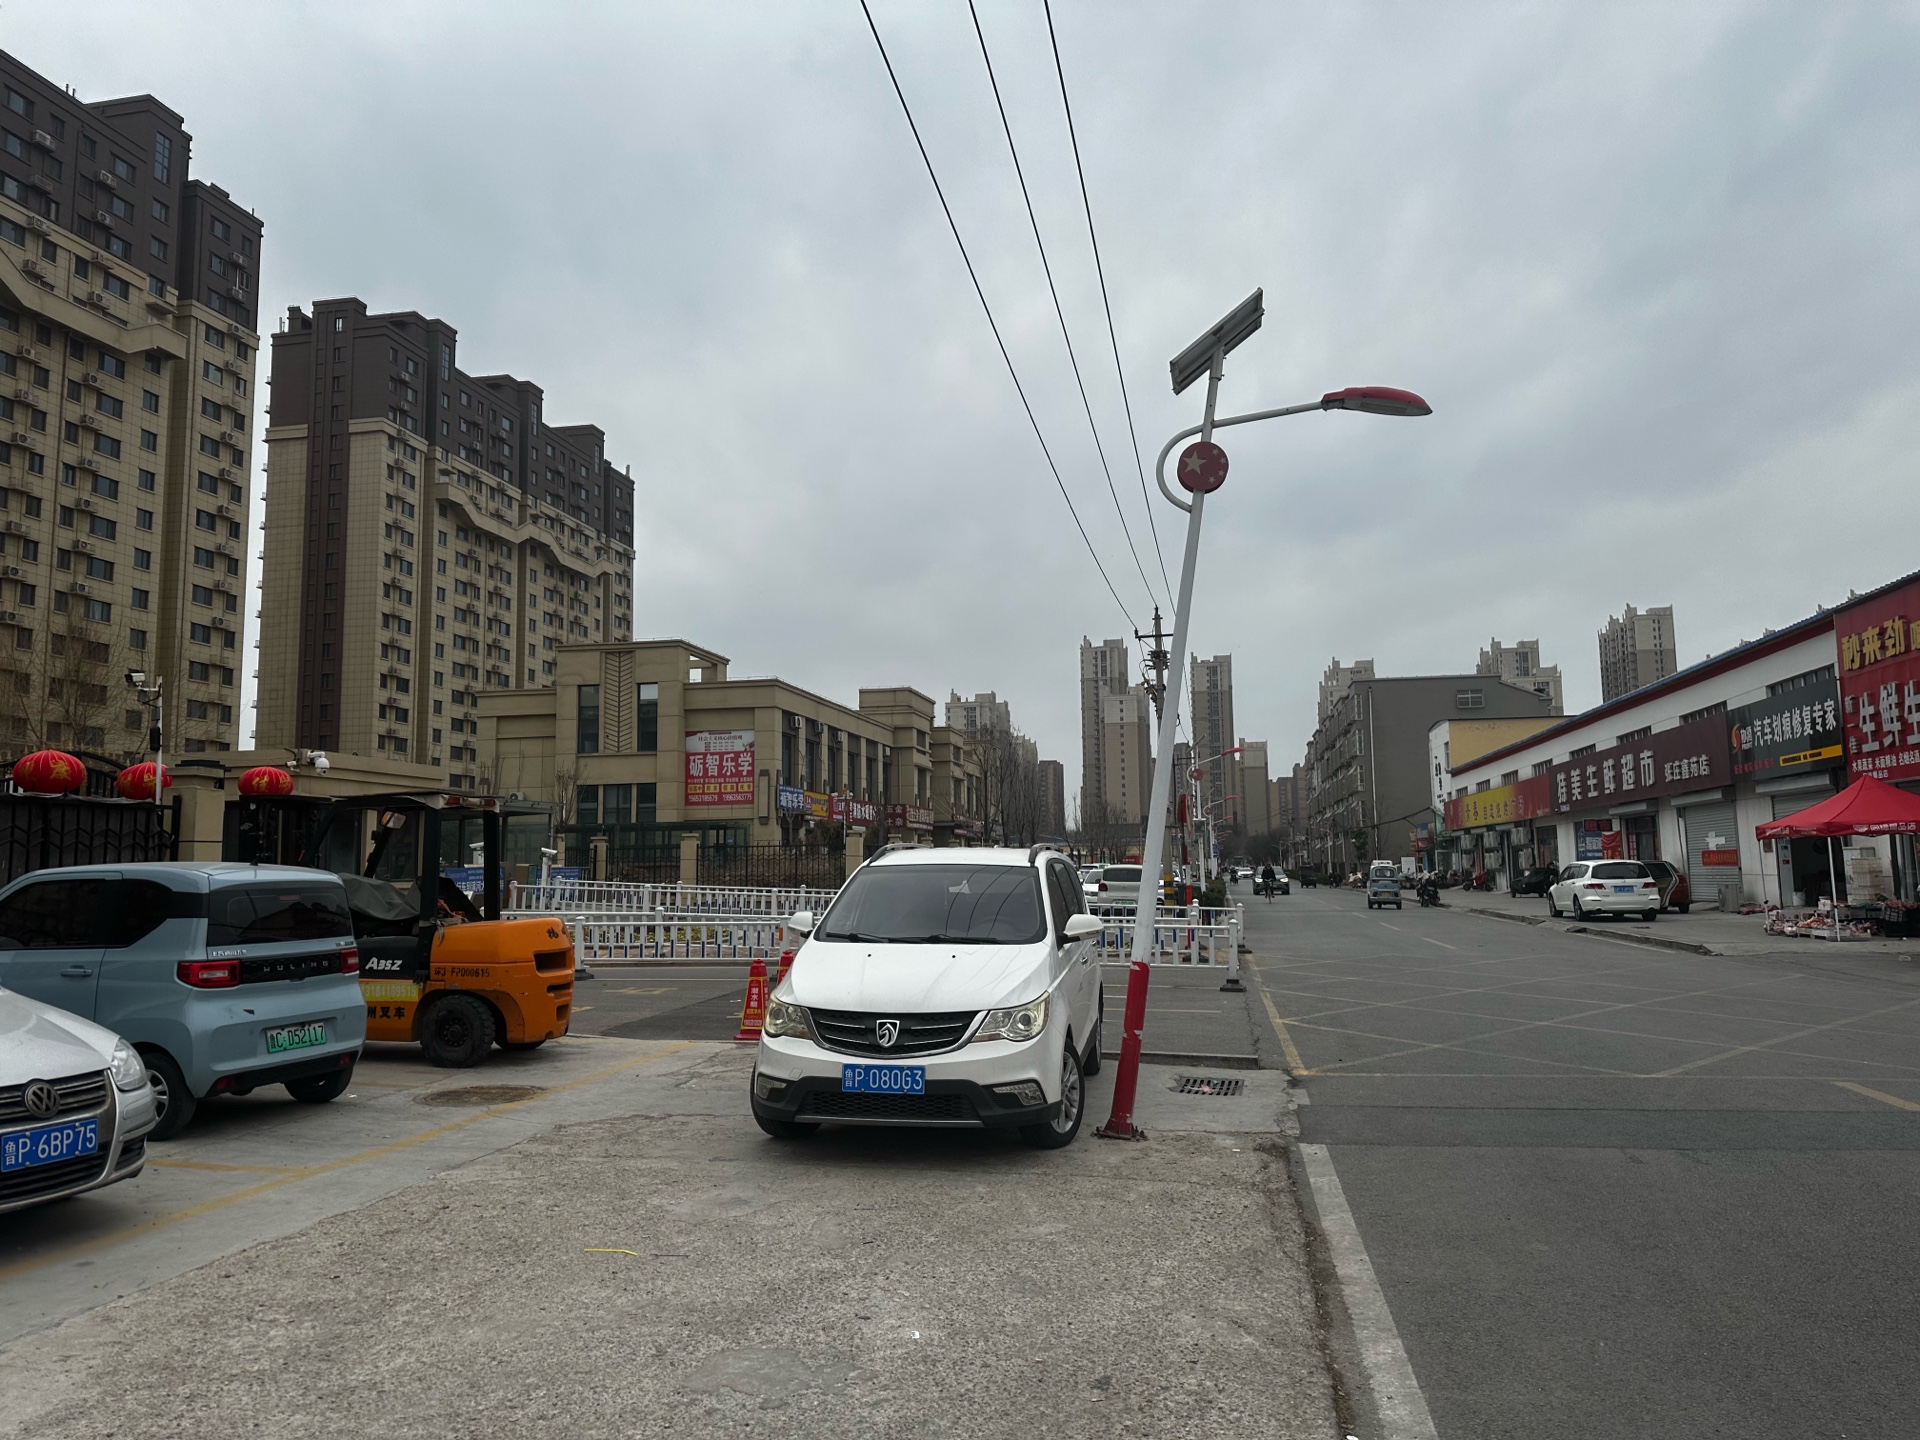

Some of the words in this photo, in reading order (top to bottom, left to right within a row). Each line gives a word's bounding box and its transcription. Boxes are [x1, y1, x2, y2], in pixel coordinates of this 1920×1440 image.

[1753, 698, 1836, 747] 汽车划痕修复专家
[689, 752, 752, 776] 砺智乐学
[1664, 753, 1711, 783] 张庄鑫苑店
[1852, 757, 1873, 773] 水果蔬菜
[1875, 754, 1897, 769] 米面粮油
[886, 805, 903, 813] 五金
[263, 960, 328, 972] WULING
